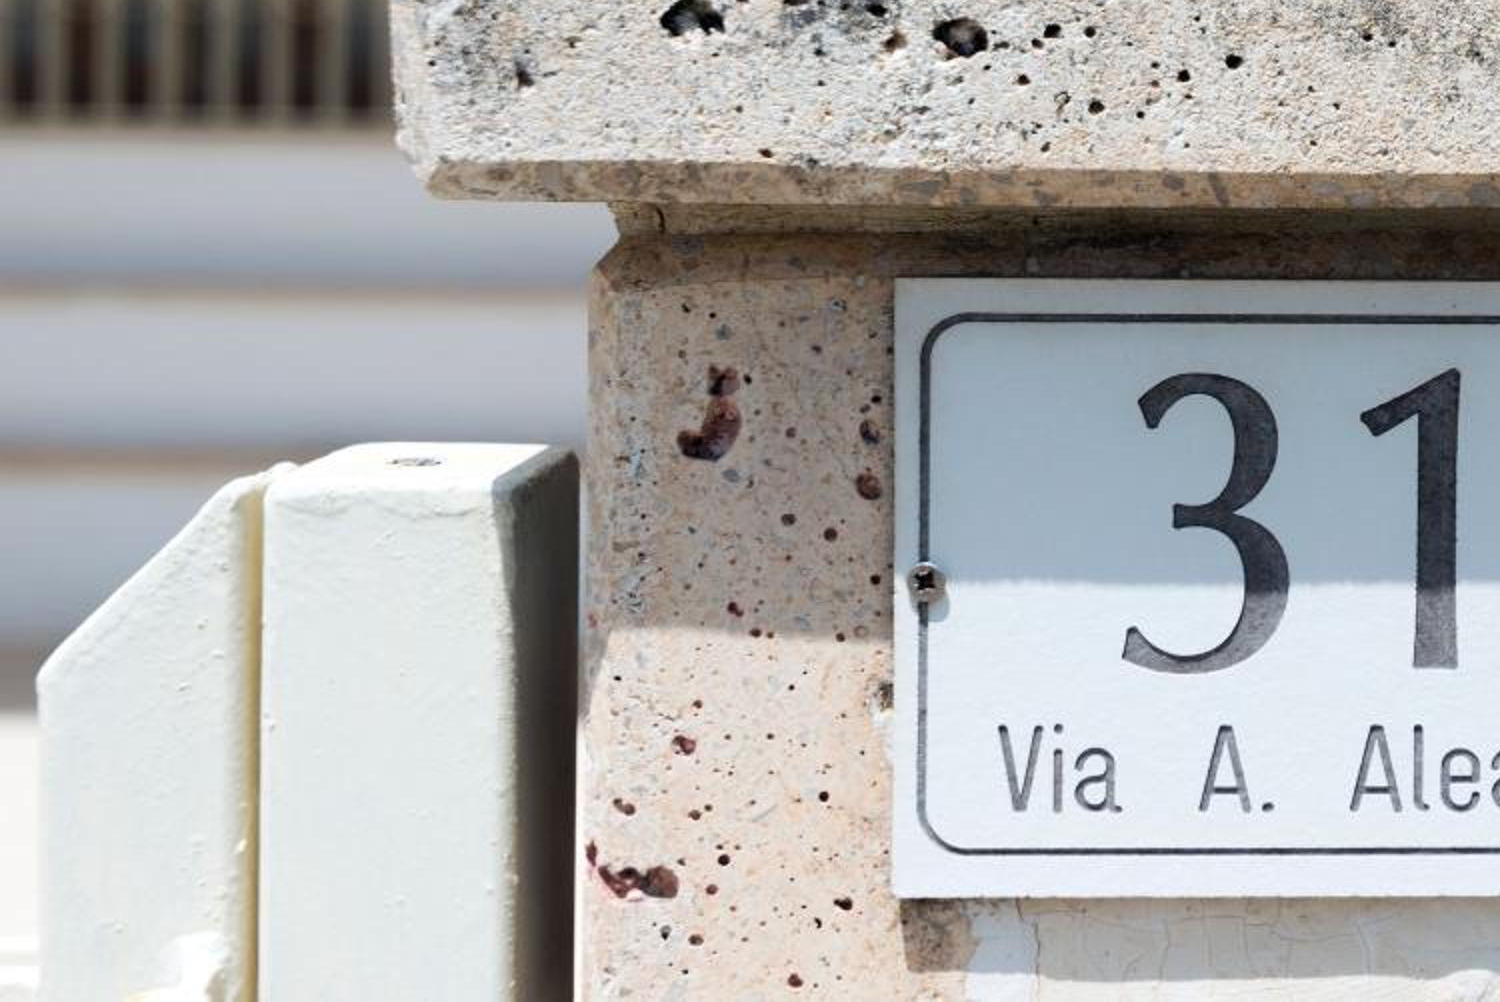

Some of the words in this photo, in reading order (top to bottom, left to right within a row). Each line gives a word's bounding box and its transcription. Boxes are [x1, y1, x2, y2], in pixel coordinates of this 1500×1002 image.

[1121, 367, 1461, 674] 31
[997, 723, 1123, 813] Via
[1197, 723, 1275, 813] A.
